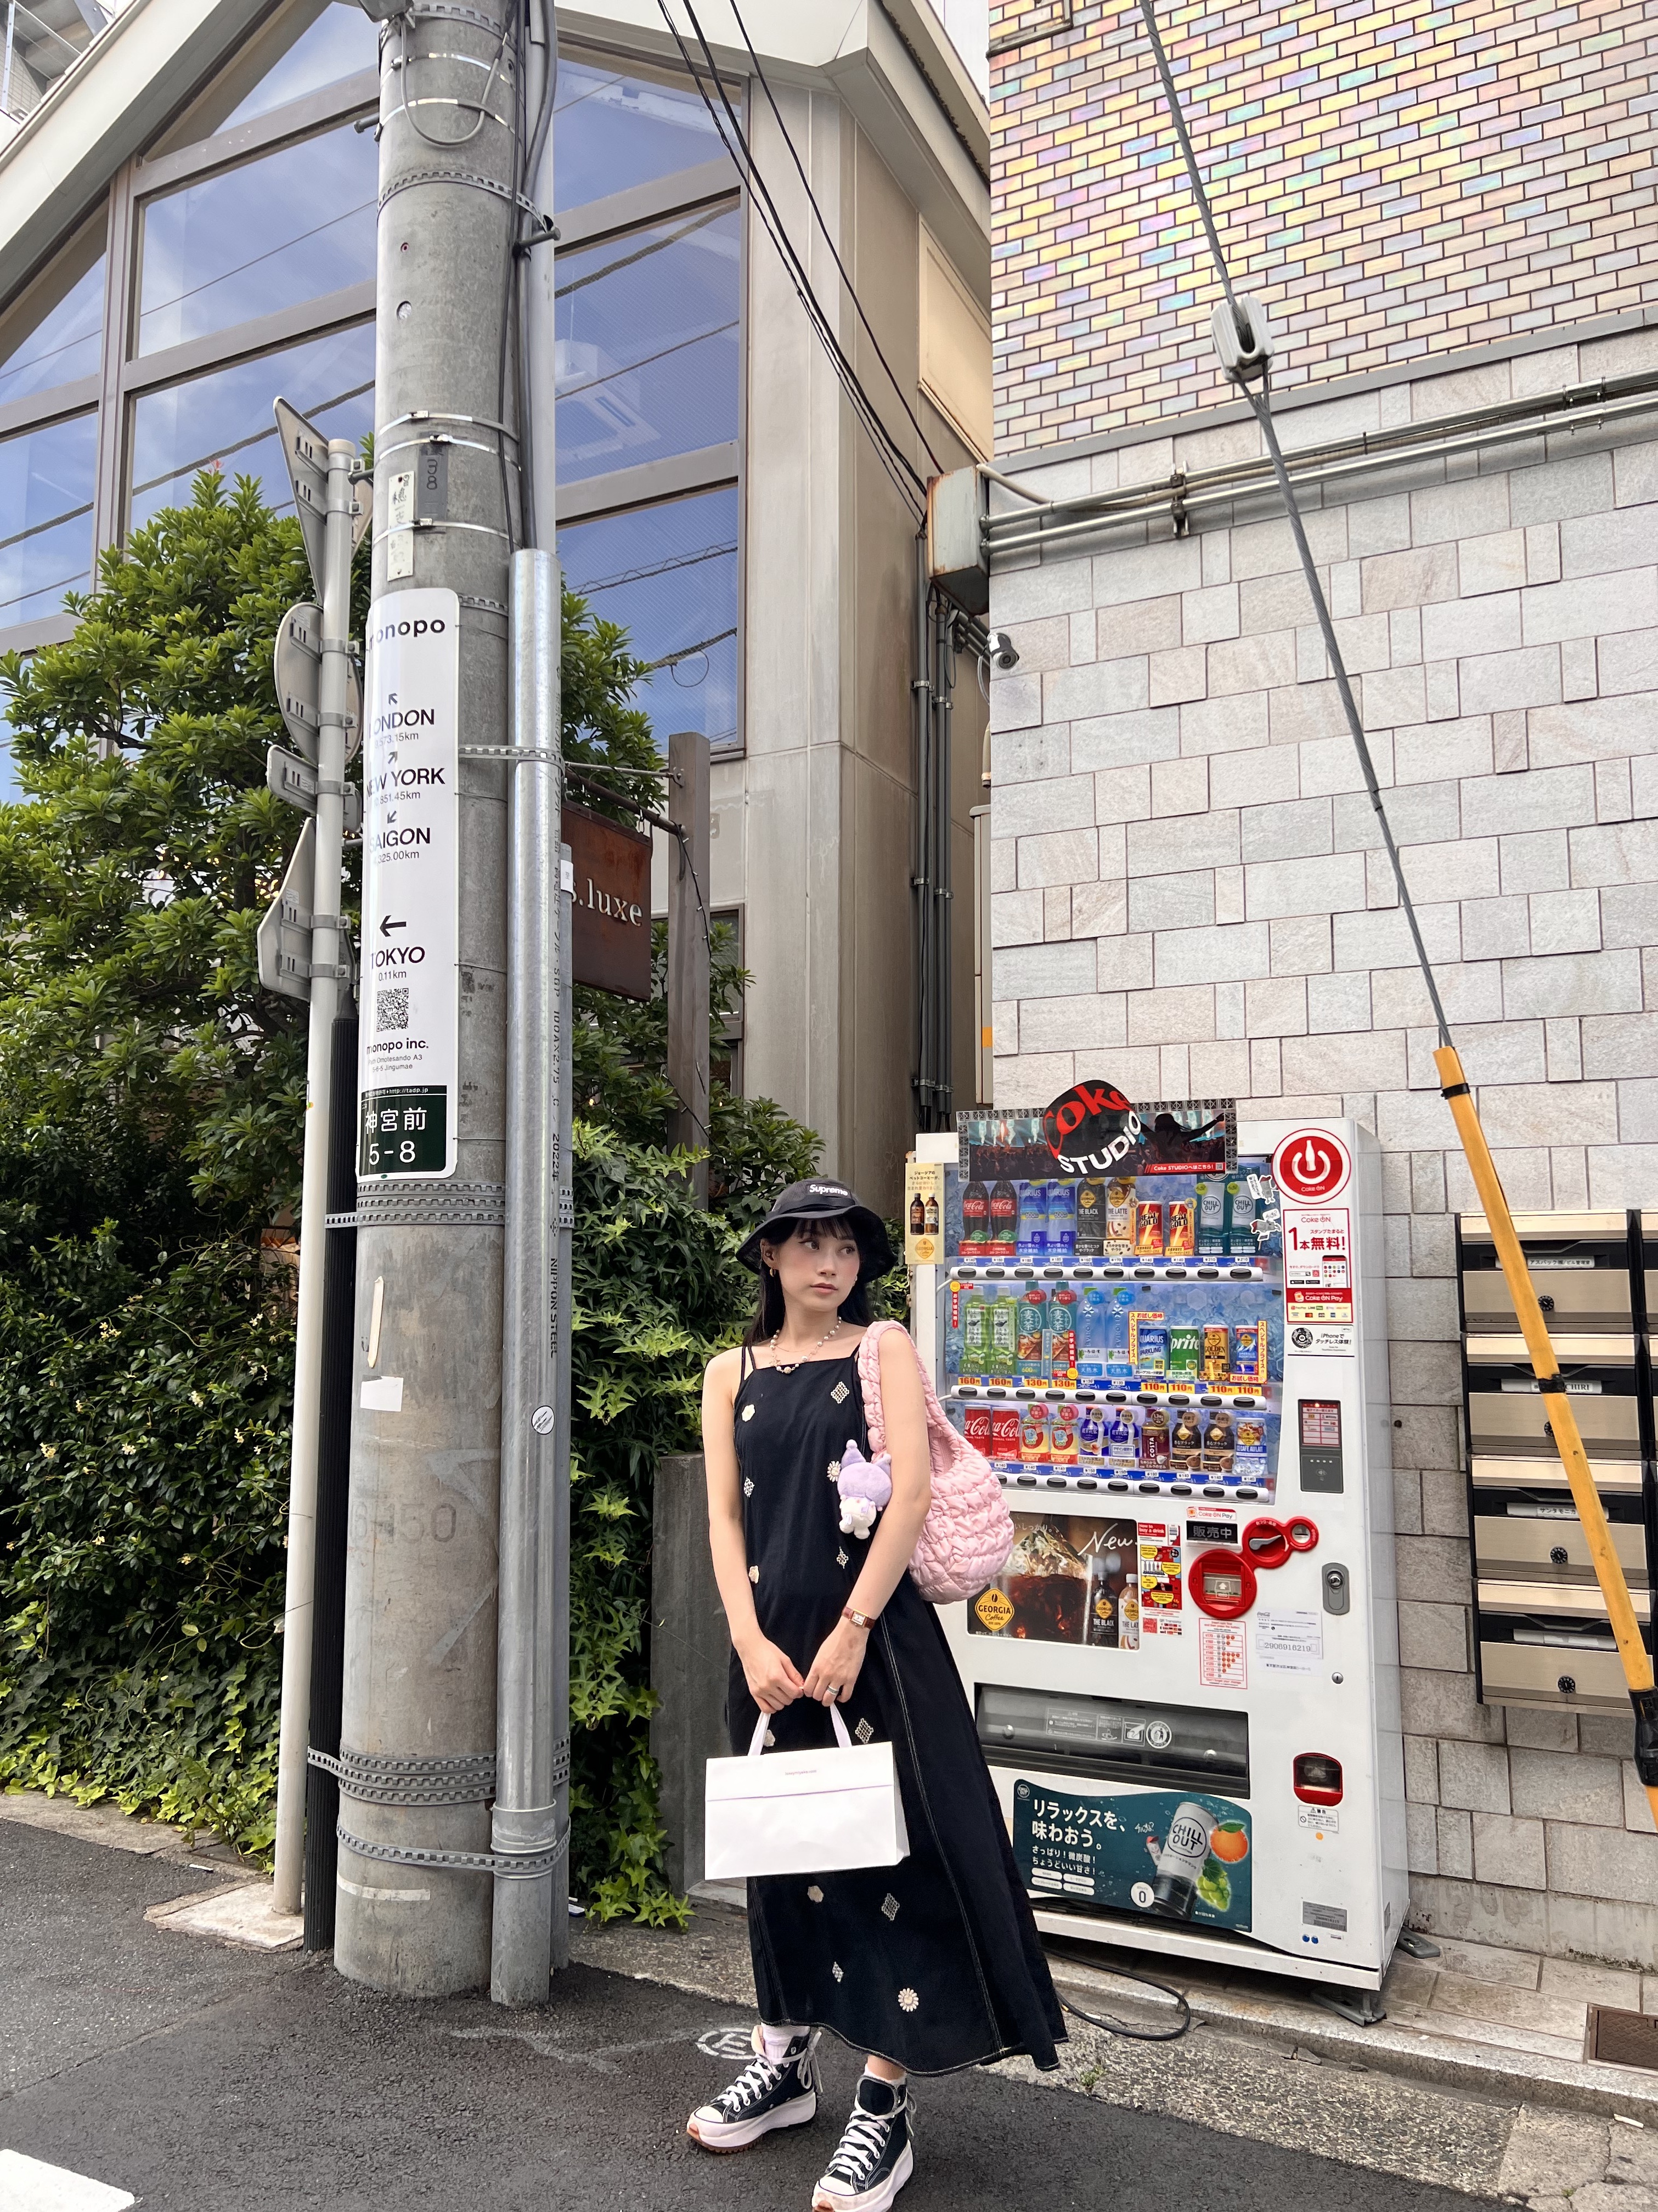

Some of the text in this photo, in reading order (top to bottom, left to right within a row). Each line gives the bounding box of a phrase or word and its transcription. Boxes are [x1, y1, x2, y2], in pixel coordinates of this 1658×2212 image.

[366, 768, 445, 798] NEW YORK
[369, 827, 431, 854] SAIGON
[370, 946, 425, 970] TOKYO
[378, 970, 407, 981] 0.11km
[366, 1037, 429, 1054] monopo inc.
[365, 1107, 427, 1135] 神宮前
[1057, 1109, 1142, 1174] STUDIO
[369, 1140, 416, 1165] 5-8
[809, 1184, 848, 1196] Supreme
[1140, 1210, 1158, 1222] REAL
[1140, 1217, 1158, 1228] GOLD
[1170, 1211, 1188, 1222] REAL
[1170, 1218, 1188, 1229] GOLD
[1023, 1309, 1035, 1331] 麦茶
[1053, 1309, 1064, 1331] 麦茶
[1170, 1334, 1200, 1353] prite
[1193, 1525, 1232, 1539] 販売中
[978, 1605, 1011, 1615] GEORGIA
[1101, 1618, 1114, 1627] BLACK
[1034, 1799, 1125, 1832] リラックスを、
[1031, 1820, 1102, 1850] 味わおう。
[1172, 1824, 1203, 1846] CHILL
[1172, 1834, 1197, 1850] OUT
[1138, 1891, 1146, 1903] 0
